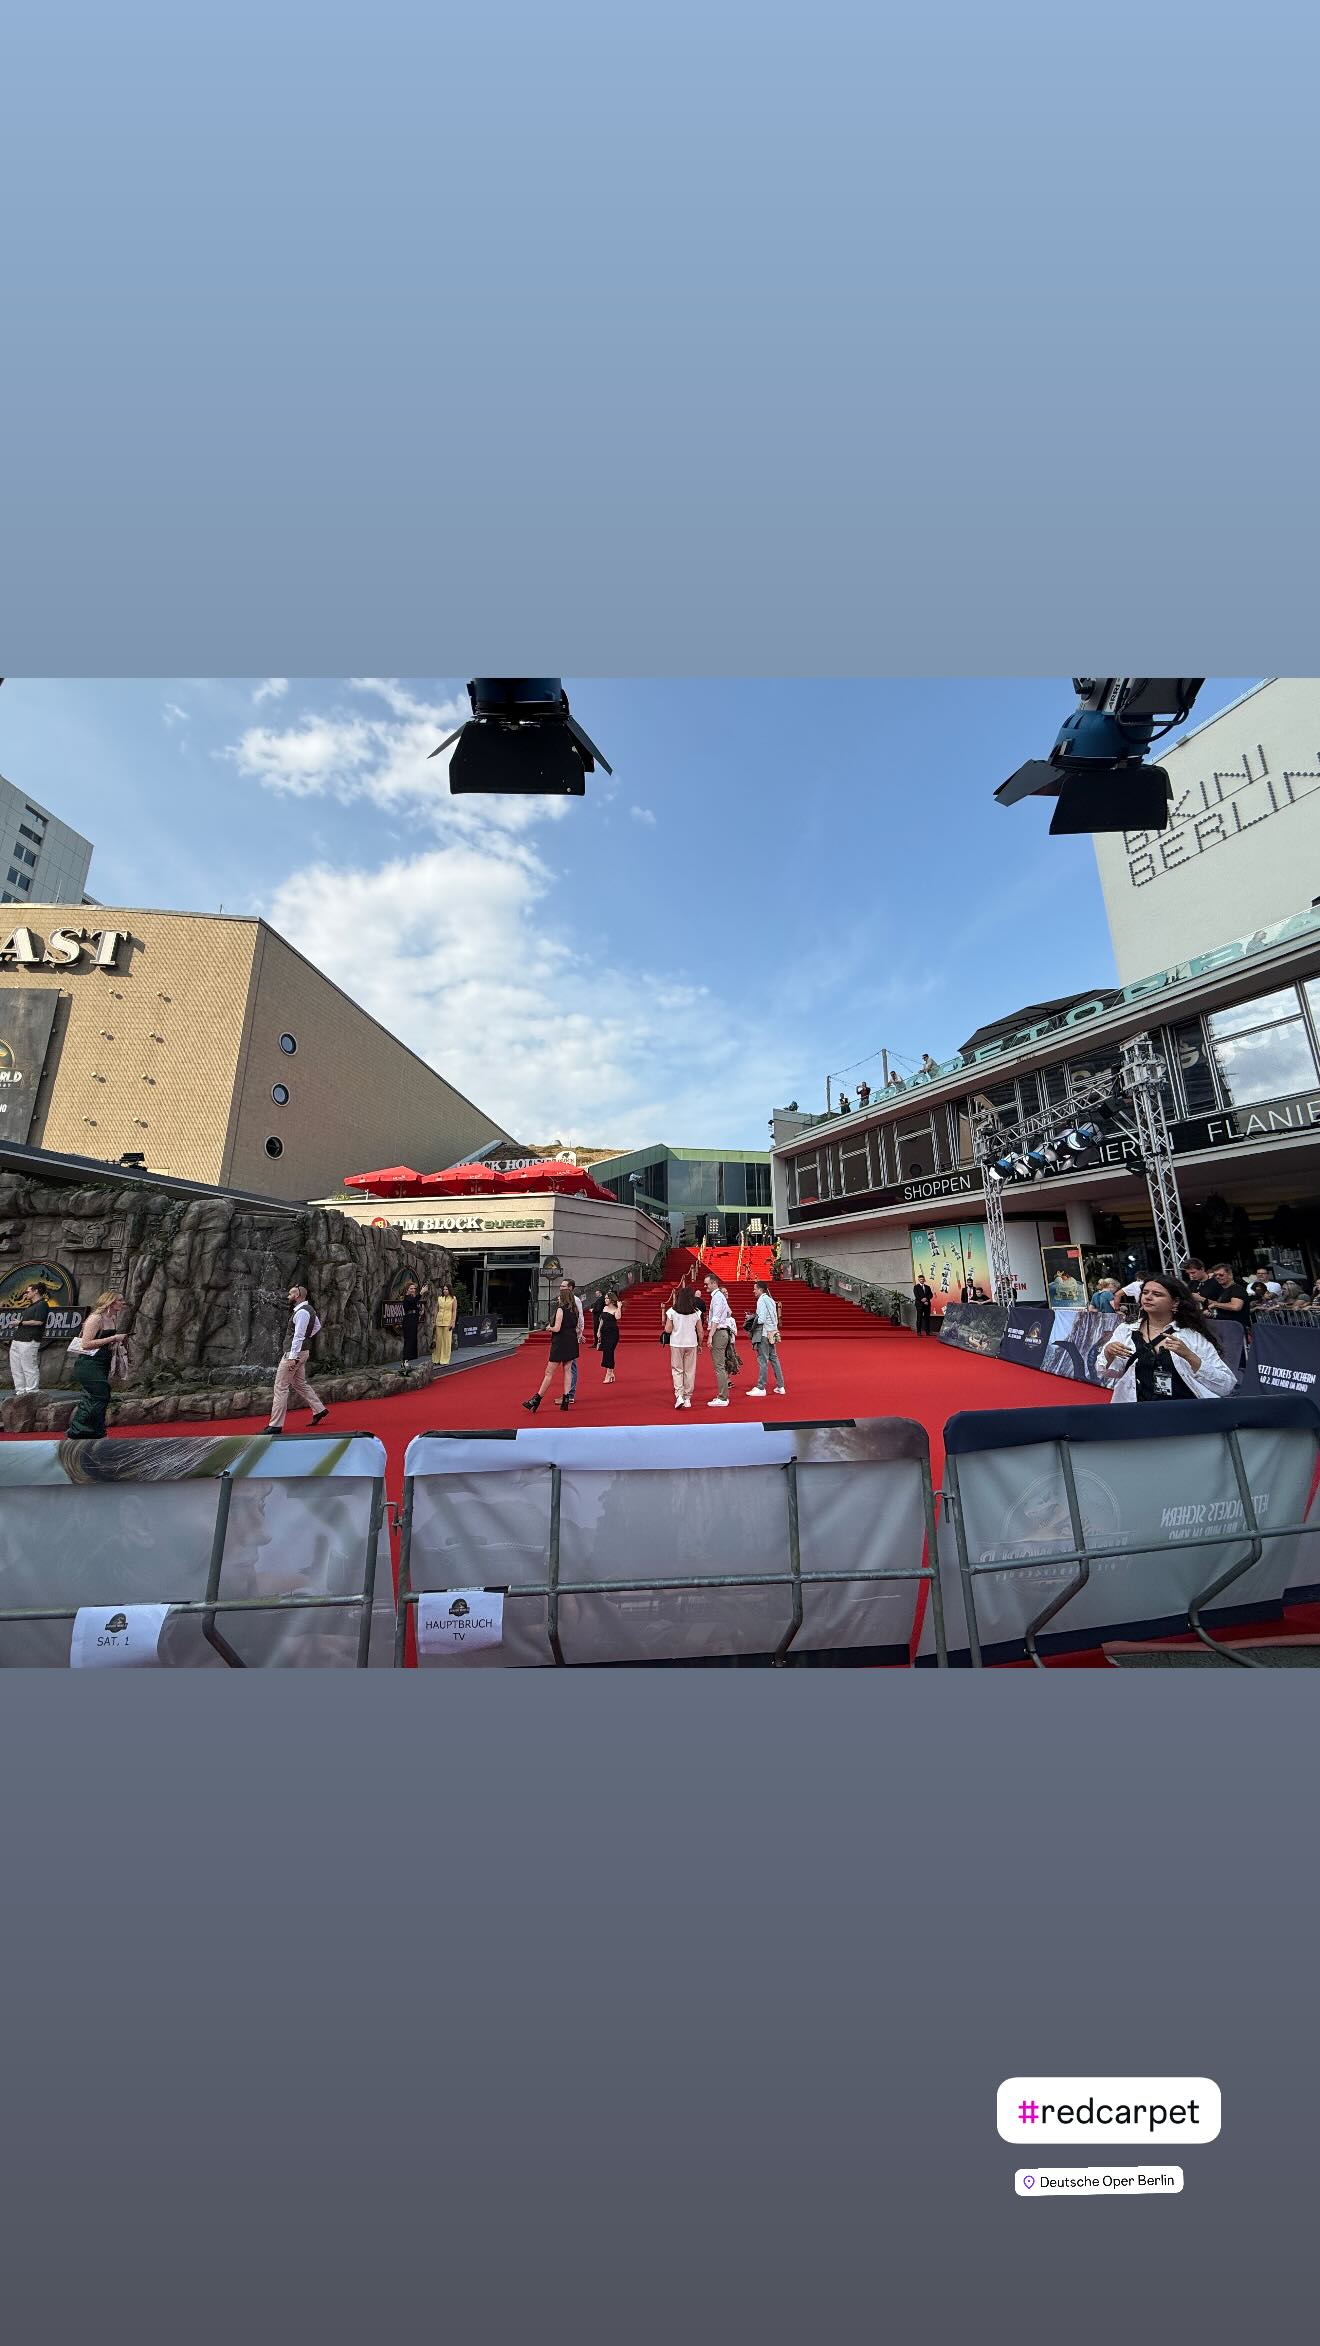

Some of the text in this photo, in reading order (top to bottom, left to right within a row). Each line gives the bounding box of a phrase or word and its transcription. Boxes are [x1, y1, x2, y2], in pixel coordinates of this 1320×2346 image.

[1123, 743, 1269, 855] BKINI
[1128, 750, 1320, 887] BERLIN
[0, 926, 132, 968] AST
[0, 1071, 22, 1083] RLD
[1207, 1100, 1320, 1142] FLANIE
[904, 1174, 971, 1201] SHOPPEN
[423, 1216, 481, 1231] BLOCK
[484, 1218, 546, 1230] BURGER
[45, 1311, 82, 1329] ORLD
[1272, 1367, 1292, 1379] TICKETS
[1292, 1371, 1316, 1384] SICHERN
[425, 1618, 493, 1630] HAUPTBRUCH
[453, 1632, 466, 1641] TV
